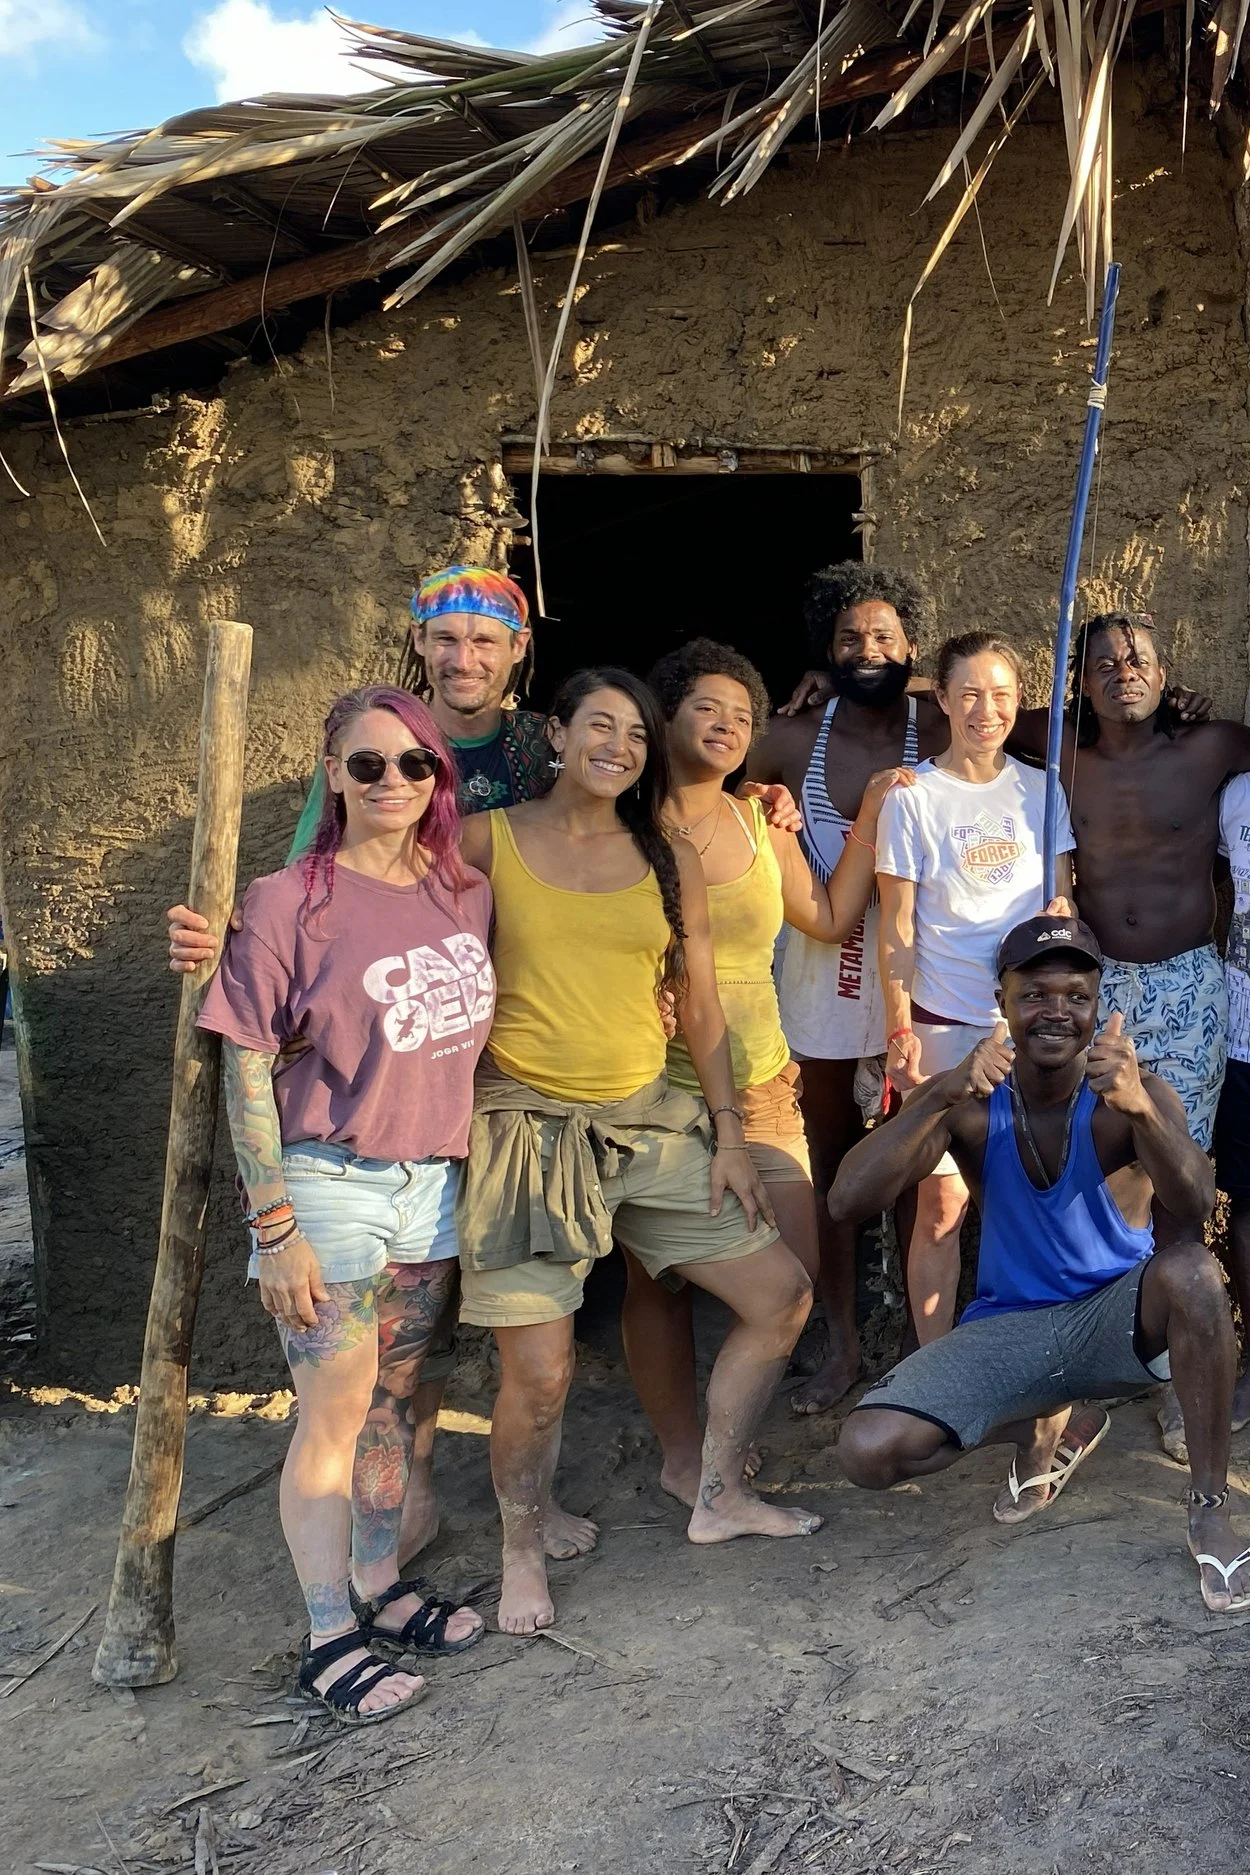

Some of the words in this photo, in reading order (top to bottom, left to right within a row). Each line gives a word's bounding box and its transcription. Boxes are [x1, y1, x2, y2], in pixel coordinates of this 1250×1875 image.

[970, 845, 1016, 863] FORCE
[1051, 928, 1072, 938] cdc
[431, 1045, 459, 1060] JOGA
